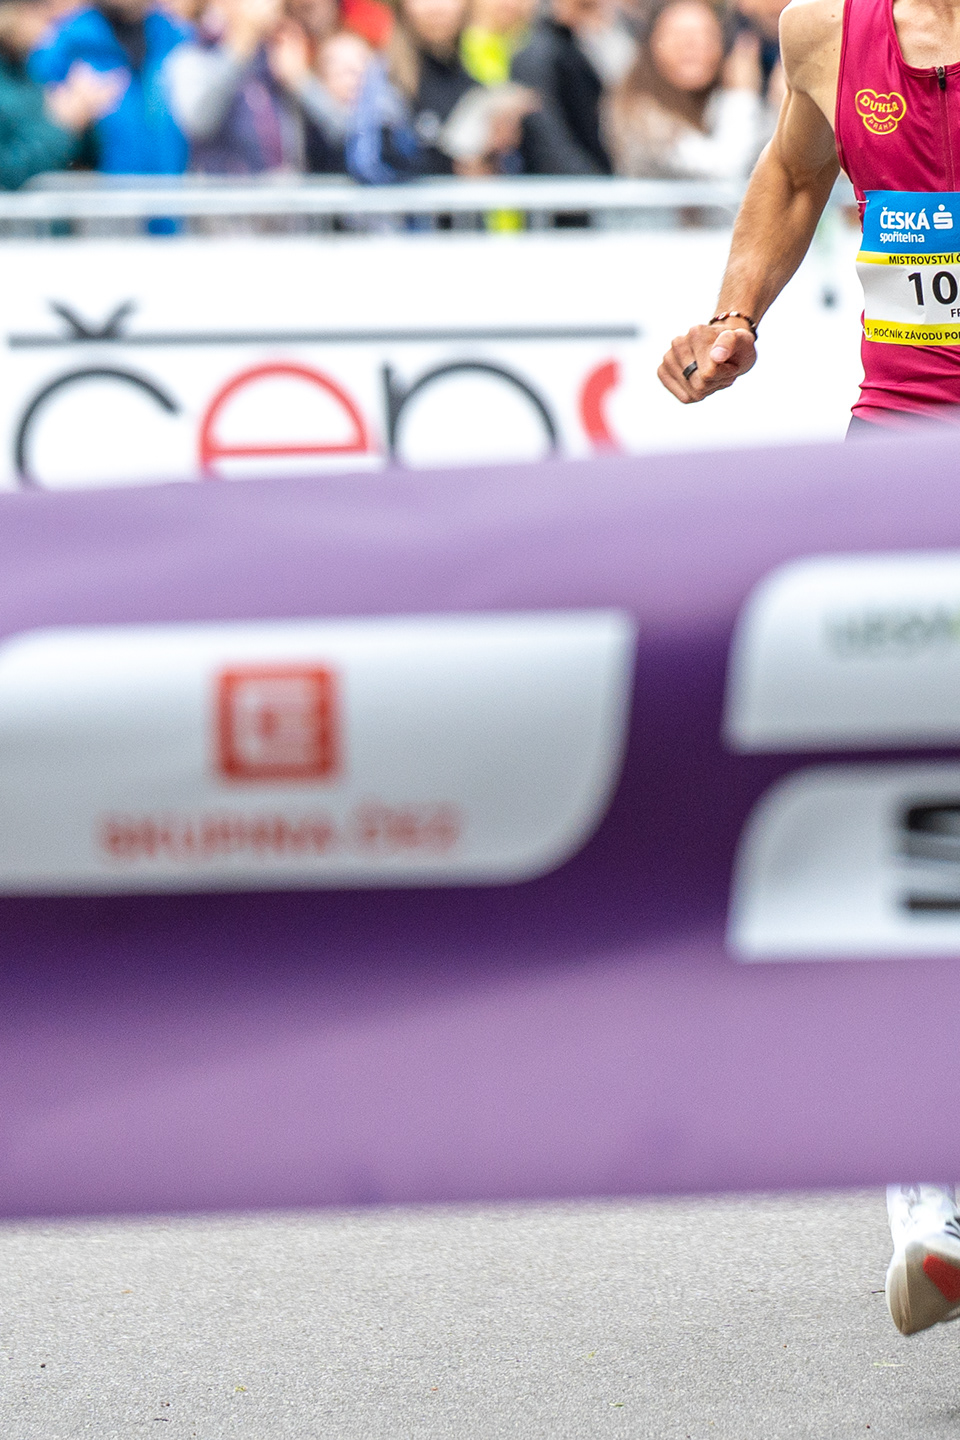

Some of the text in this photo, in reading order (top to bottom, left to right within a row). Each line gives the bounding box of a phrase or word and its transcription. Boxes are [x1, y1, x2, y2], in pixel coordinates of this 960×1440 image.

[860, 95, 899, 113] DUKLA
[868, 118, 893, 131] PRAHA
[880, 206, 930, 231] ČESKÁ
[879, 231, 925, 244] spořitelna
[888, 252, 954, 265] MISTROVSTVÍ
[873, 327, 903, 339] ROČNÍK
[904, 330, 943, 340] ZÁVODU
